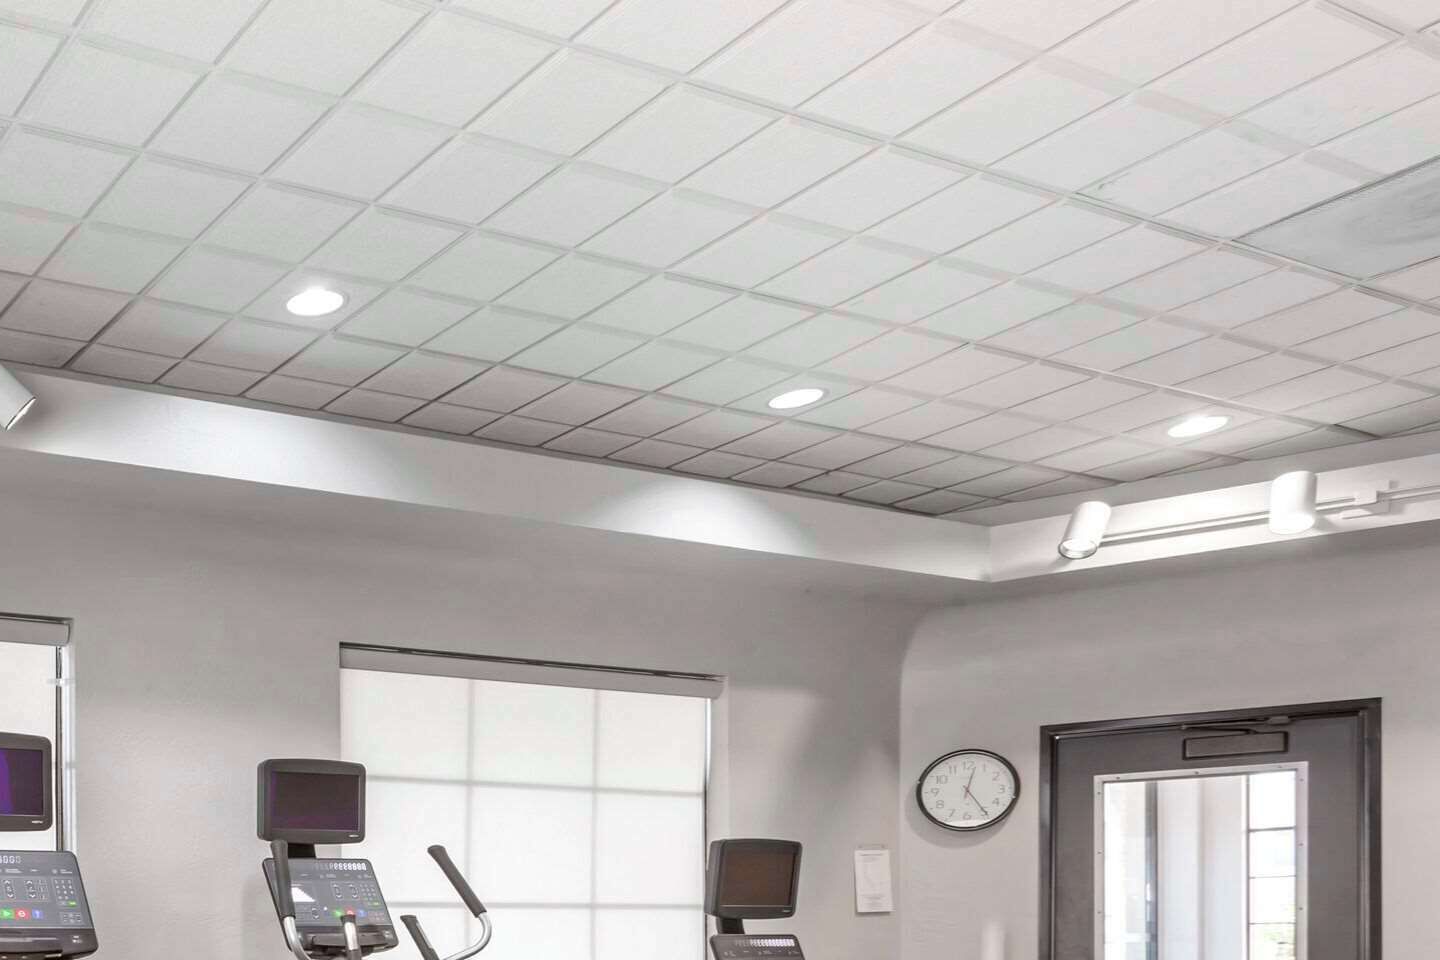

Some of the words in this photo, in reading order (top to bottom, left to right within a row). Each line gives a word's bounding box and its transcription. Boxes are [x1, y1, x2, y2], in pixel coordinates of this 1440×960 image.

[962, 760, 976, 770] 12
[949, 765, 958, 775] 11
[936, 775, 949, 784] 10
[992, 771, 1001, 781] 2
[930, 788, 940, 797] 9
[998, 784, 1006, 793] 3
[936, 800, 945, 809] 8
[991, 797, 1000, 806] 4
[962, 811, 972, 820] 6
